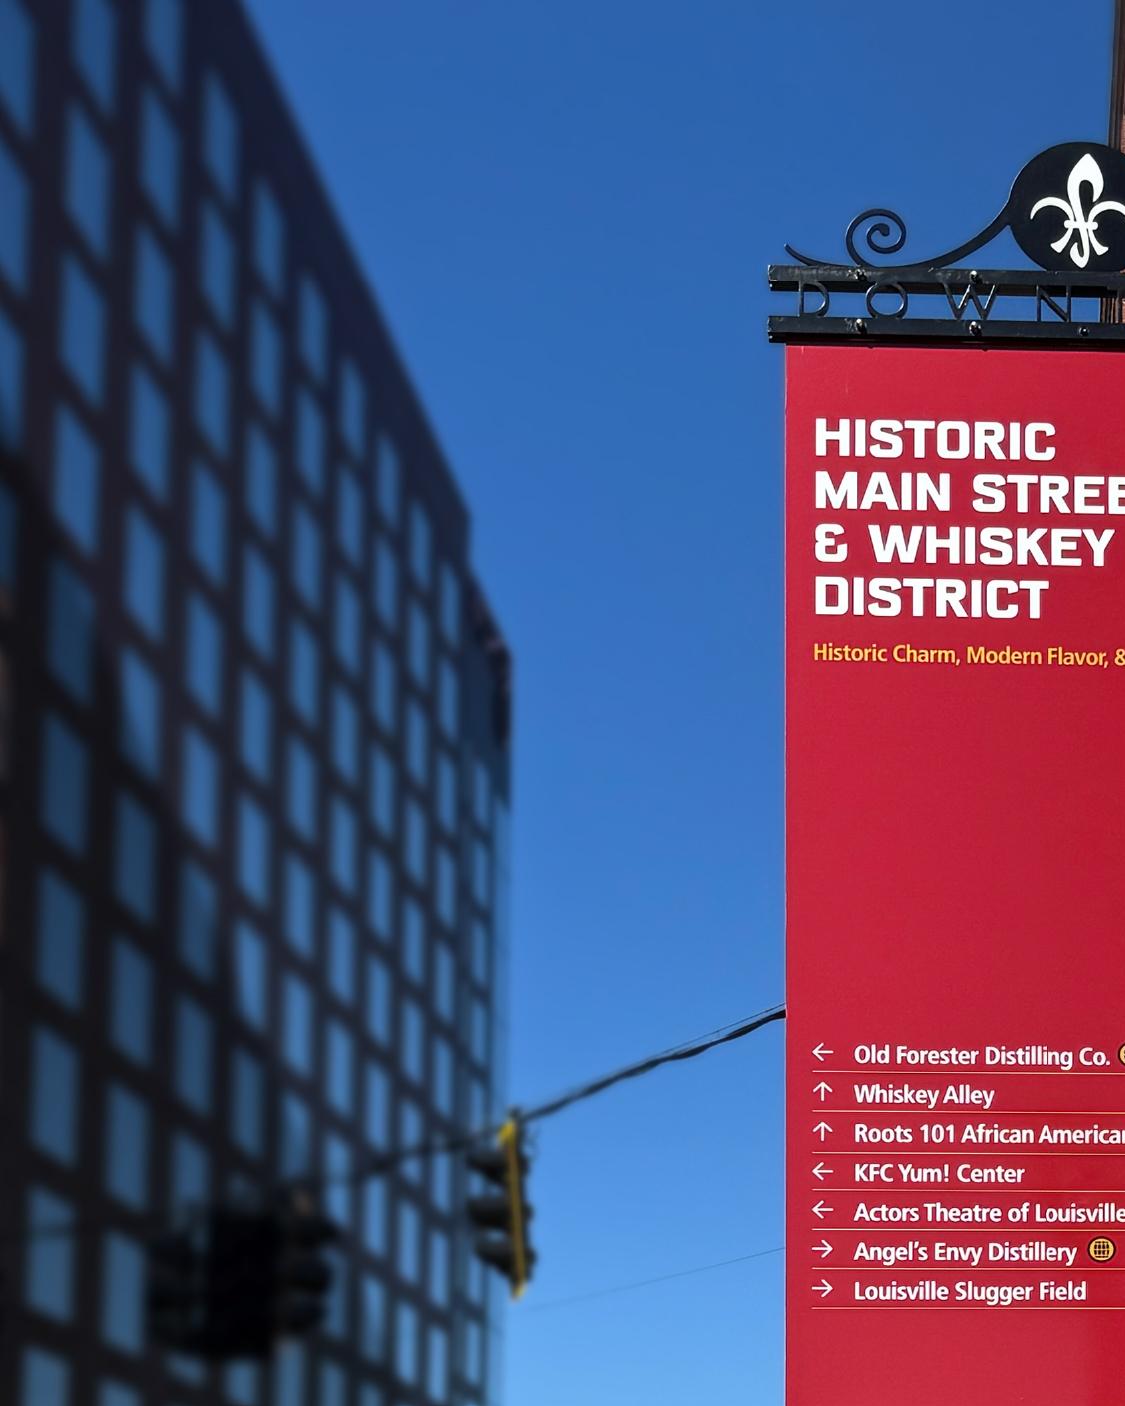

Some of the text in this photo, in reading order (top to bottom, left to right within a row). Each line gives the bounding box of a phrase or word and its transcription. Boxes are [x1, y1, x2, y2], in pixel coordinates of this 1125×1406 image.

[815, 417, 1056, 461] HISTORIC
[814, 470, 951, 512] MAIN
[814, 522, 848, 563] &
[867, 524, 1116, 567] WHISKEY
[814, 575, 1050, 619] DISTRICT
[813, 642, 888, 662] Historic
[892, 643, 961, 666] Charm,
[966, 645, 1043, 665] Modern
[1047, 646, 1109, 669] Flavor,
[854, 1043, 1111, 1071] Old Forester Distilling Co.
[853, 1083, 995, 1110] Whiskey Alley
[854, 1123, 913, 1144] Roots
[919, 1123, 955, 1144] 101
[960, 1123, 1035, 1144] African
[854, 1163, 1026, 1183] KFC Yum! Center
[853, 1202, 920, 1222] Actors
[922, 1201, 1003, 1223] Theatre
[1007, 1201, 1031, 1223] of
[853, 1240, 1078, 1267] Angel’s Envy Distillery
[854, 1280, 1087, 1306] Louisville Slugger Field
